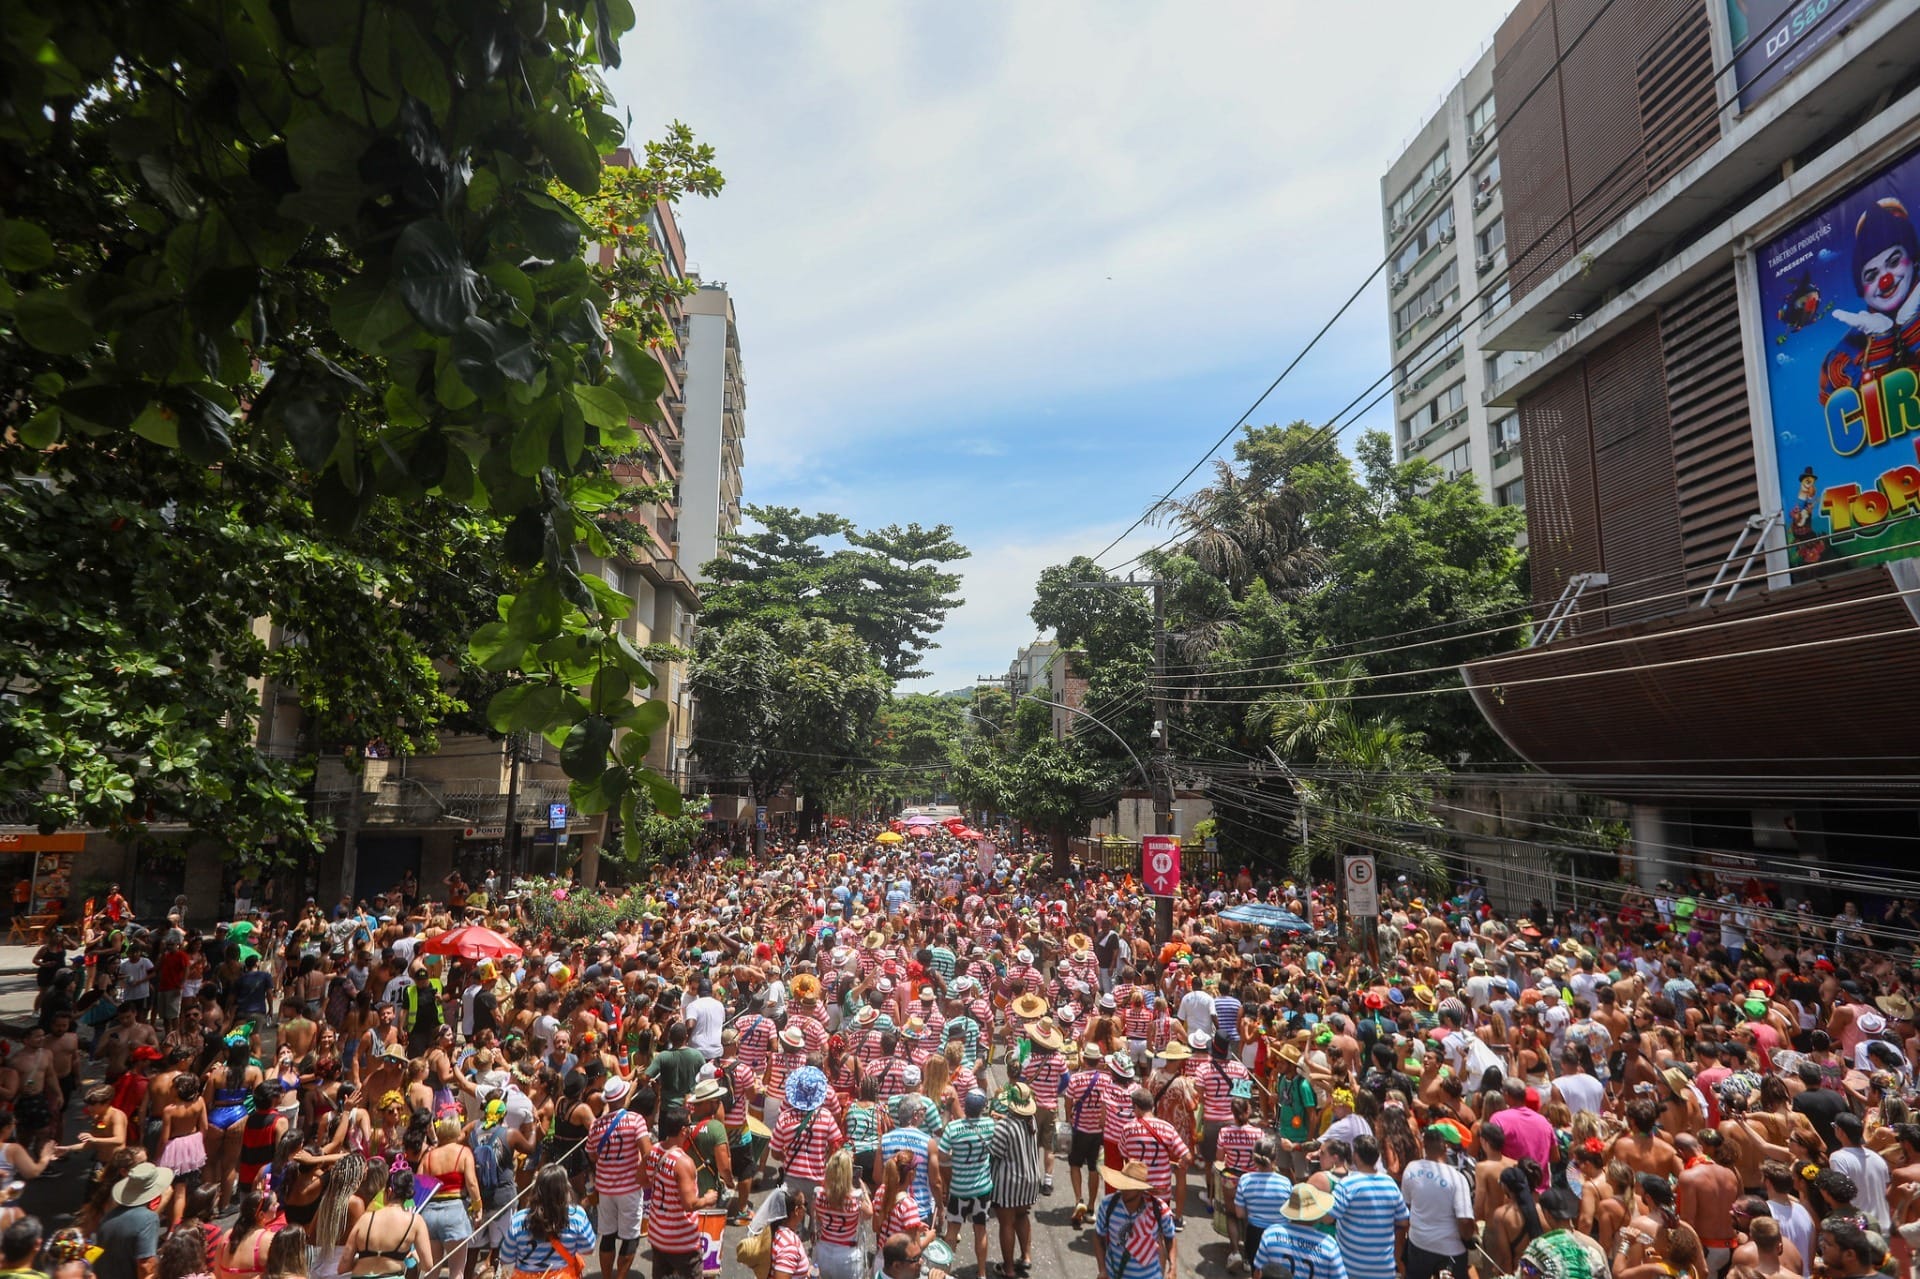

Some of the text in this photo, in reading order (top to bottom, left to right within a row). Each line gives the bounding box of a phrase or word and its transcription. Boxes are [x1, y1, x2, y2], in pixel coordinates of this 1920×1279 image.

[1775, 251, 1814, 278] APRESENTA
[1825, 368, 1920, 456] CIR
[476, 827, 503, 835] PONTO
[1356, 865, 1365, 879] E
[825, 1213, 846, 1233] 22
